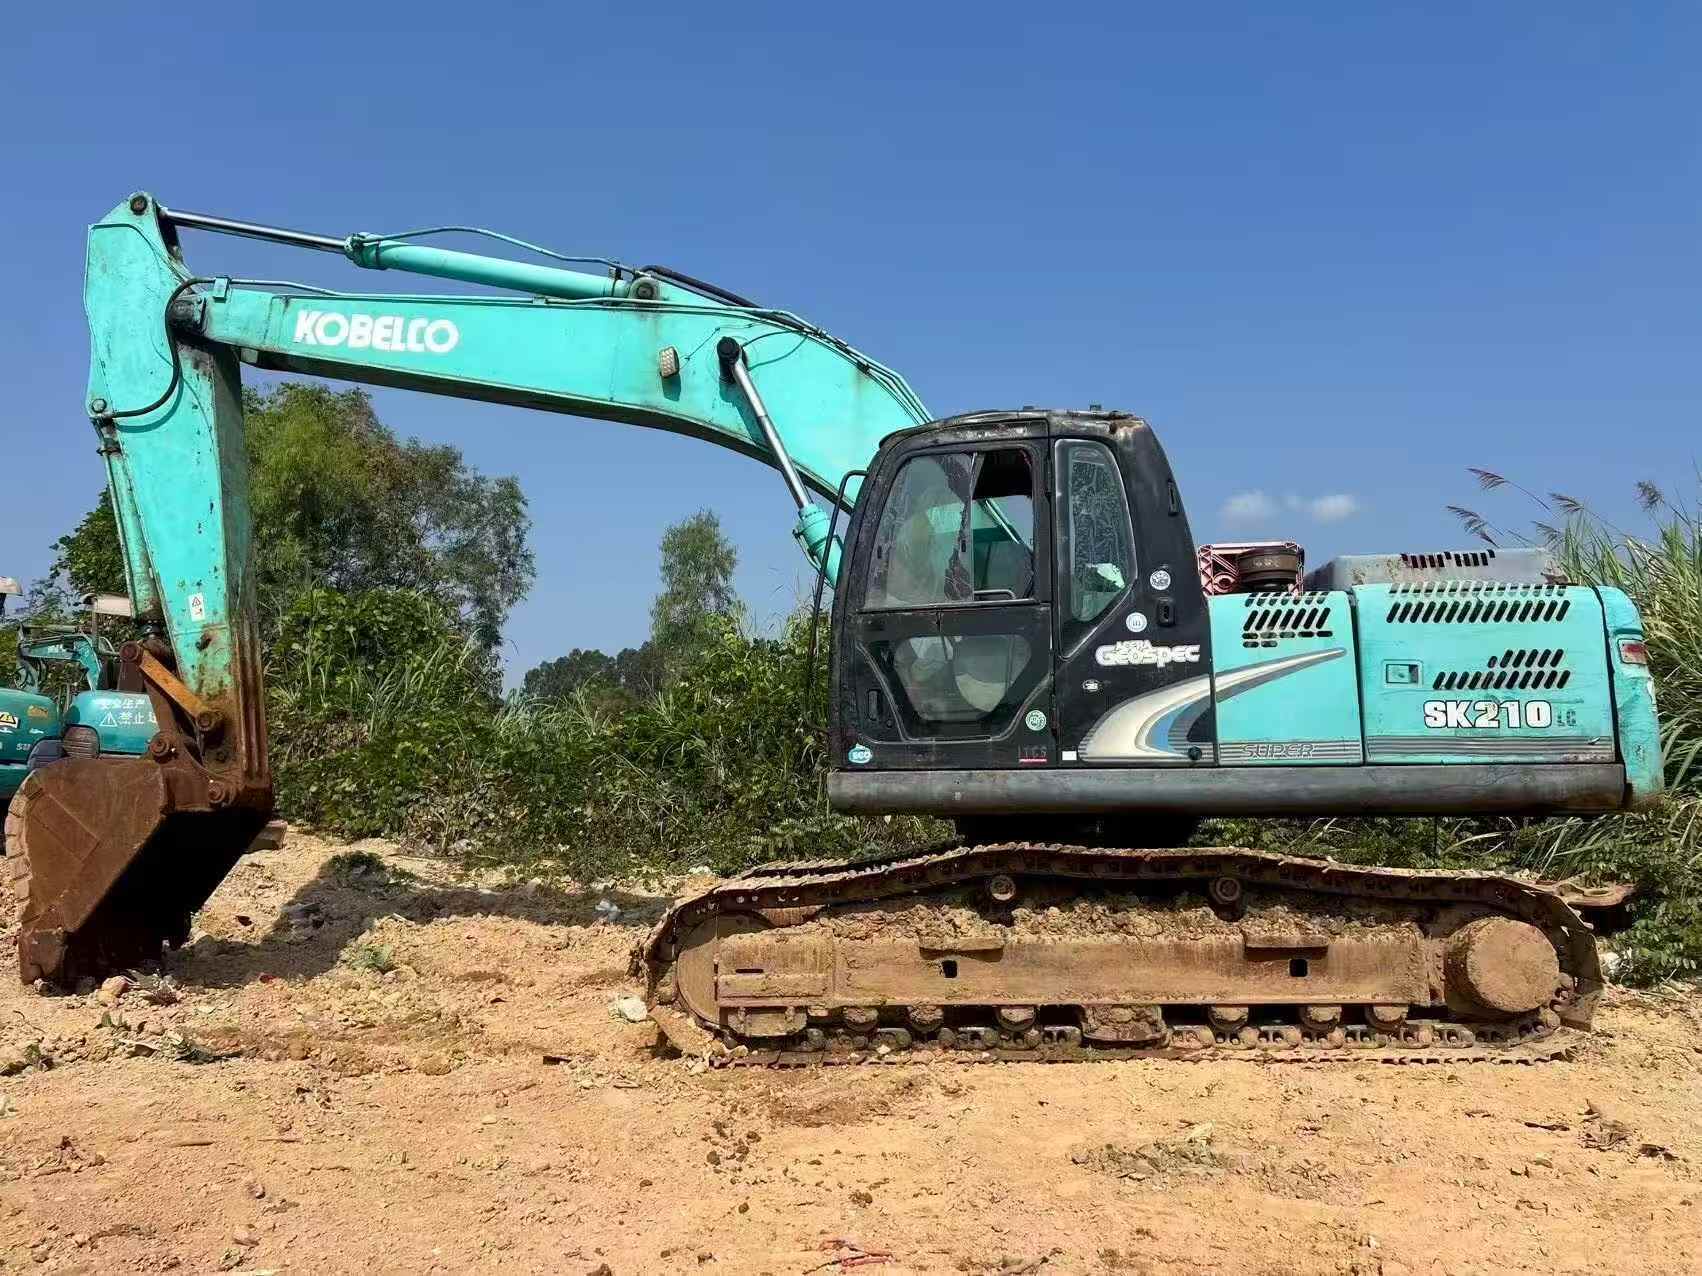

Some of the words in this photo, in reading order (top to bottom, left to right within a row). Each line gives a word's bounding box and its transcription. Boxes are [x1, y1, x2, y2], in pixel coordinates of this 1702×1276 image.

[294, 309, 460, 353] KOBELCO
[1423, 700, 1552, 728] SK210
[1241, 743, 1315, 760] SUPER
